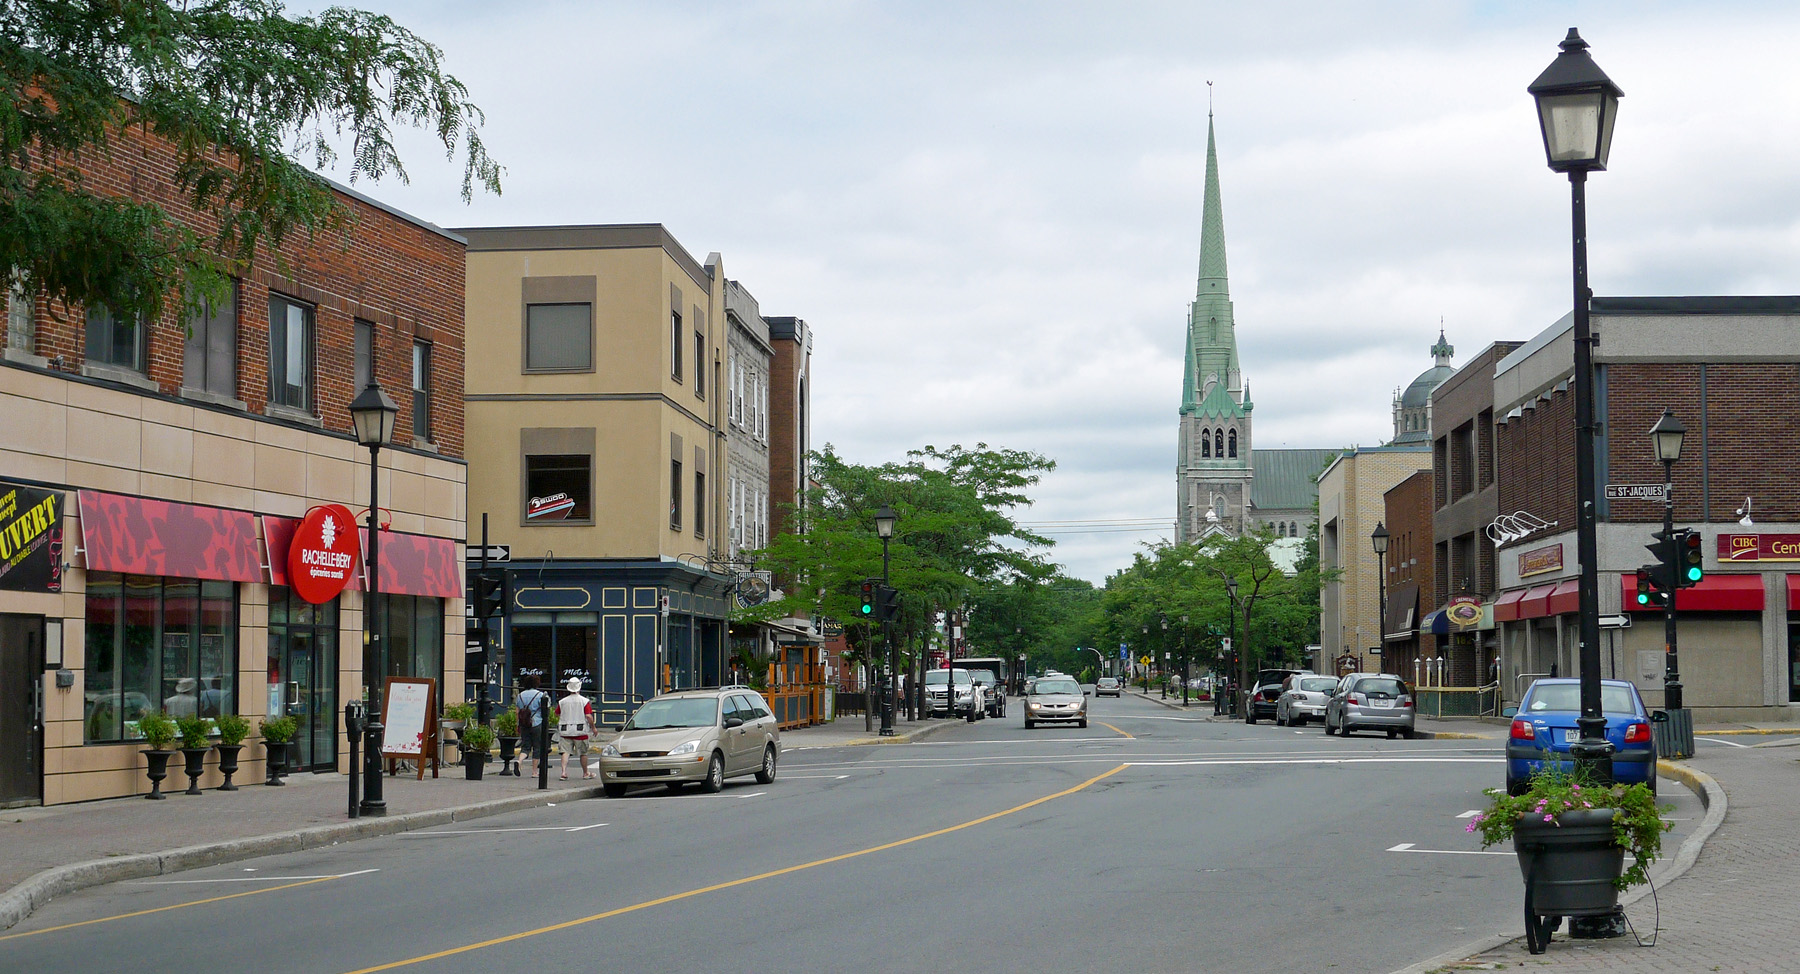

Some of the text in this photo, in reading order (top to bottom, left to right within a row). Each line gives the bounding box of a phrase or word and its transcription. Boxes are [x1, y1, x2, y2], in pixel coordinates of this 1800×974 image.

[1618, 486, 1663, 497] ST-JACQUES
[1732, 537, 1757, 547] CIBC
[519, 667, 543, 676] Bistro
